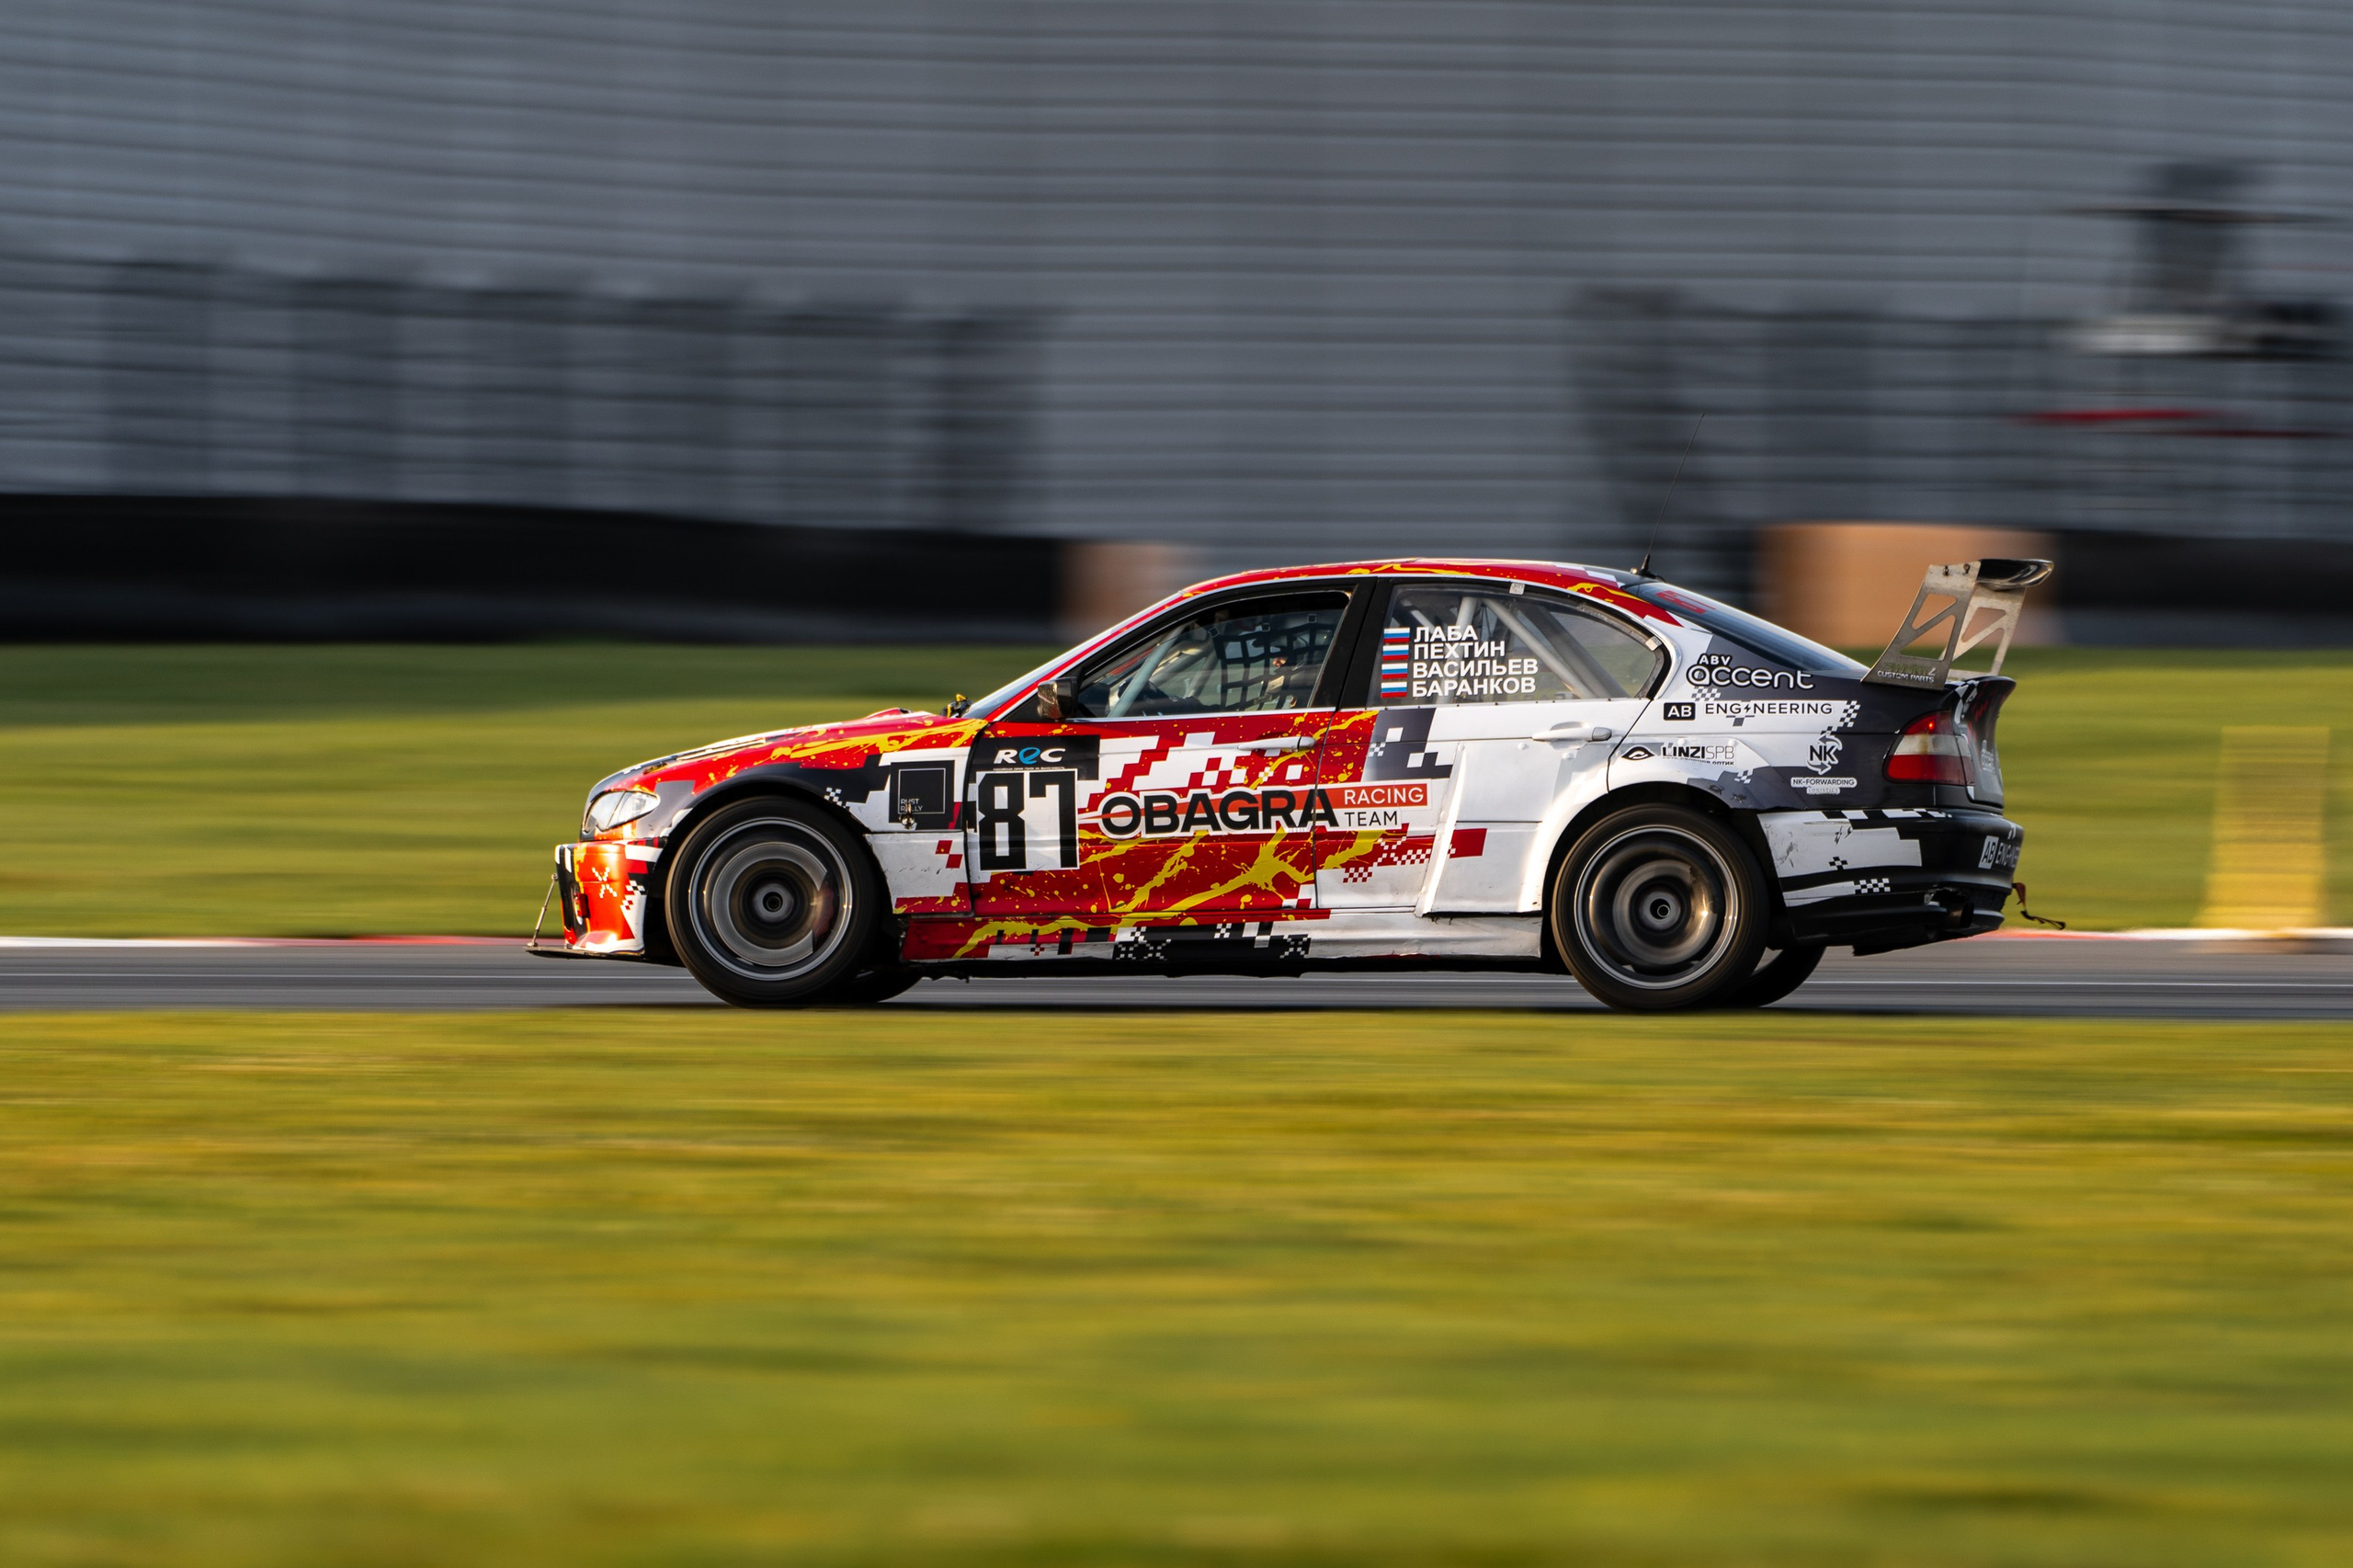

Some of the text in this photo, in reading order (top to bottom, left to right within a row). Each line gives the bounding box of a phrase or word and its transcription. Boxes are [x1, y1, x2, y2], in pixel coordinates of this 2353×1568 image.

[1414, 625, 1478, 642] ЛАБА
[1414, 641, 1506, 660] ПЕХТИН
[1413, 658, 1539, 678] ВАСИЛЬЕВ
[1688, 665, 1814, 689] accent
[1877, 670, 1935, 683] CUSTOM PARTS
[1413, 676, 1537, 698] БАРАНКОВ
[1667, 705, 1692, 718] AB
[1809, 744, 1836, 762] NK
[978, 770, 1078, 869] 87
[1101, 786, 1425, 835] OBAGRA RACING
[1344, 810, 1399, 827] TEAM
